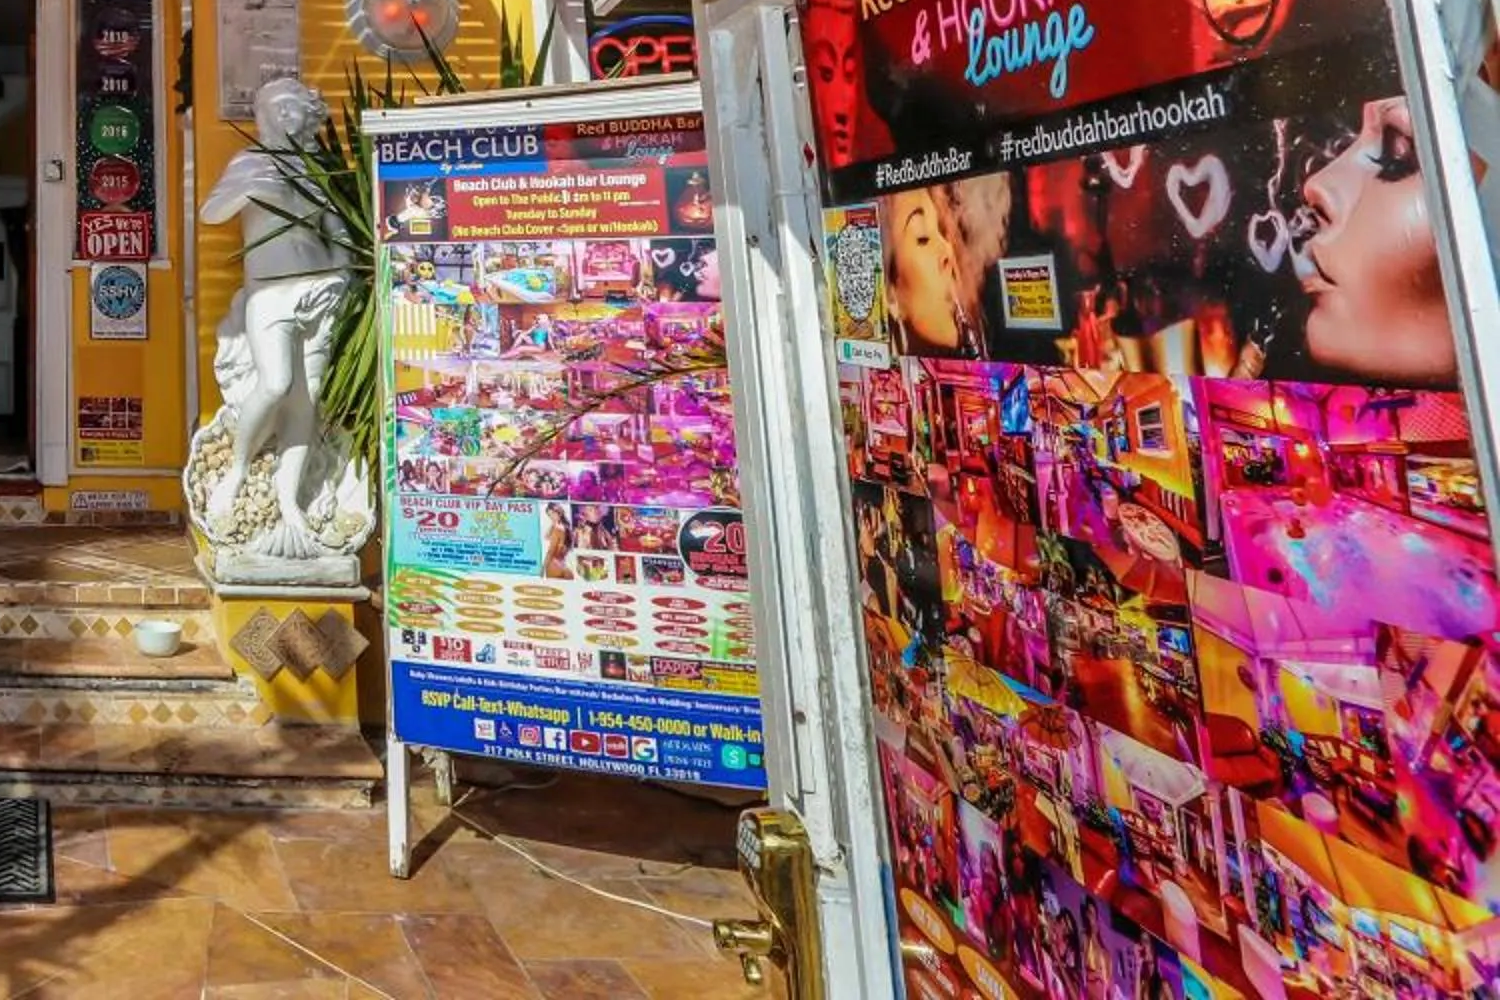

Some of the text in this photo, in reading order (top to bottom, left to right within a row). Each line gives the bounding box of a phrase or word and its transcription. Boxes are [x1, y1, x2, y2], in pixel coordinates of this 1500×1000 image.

[911, 9, 932, 64] &
[967, 2, 1095, 98] lounge
[577, 117, 700, 135] Red BUDDHA Bar
[1000, 87, 1226, 162] #redbuddahbarhookah
[381, 134, 539, 163] BEACH CLUB
[615, 132, 684, 148] HOOKAH
[876, 149, 972, 188] #RedBuddhaBar
[101, 175, 129, 188] 2015
[453, 172, 647, 191] Beach Club & Hookah Bar Lounge
[86, 214, 114, 234] YES
[506, 209, 546, 221] Tuesday
[560, 206, 597, 219] Sunday
[470, 225, 501, 237] Beach
[502, 224, 525, 235] Club
[526, 223, 556, 235] Cover
[87, 230, 144, 258] OPEN
[401, 497, 433, 508] BEACH
[435, 499, 461, 509] CLUB
[464, 500, 481, 511] VIP
[506, 502, 533, 514] PASS
[403, 507, 460, 529] $20
[653, 658, 700, 677] HAPPY
[421, 689, 761, 743] RSVP Call-Text-Whatsapp 1-954-450-0000 or Walk-in
[484, 743, 503, 756] 317
[579, 756, 645, 775] HOLLYWOOD
